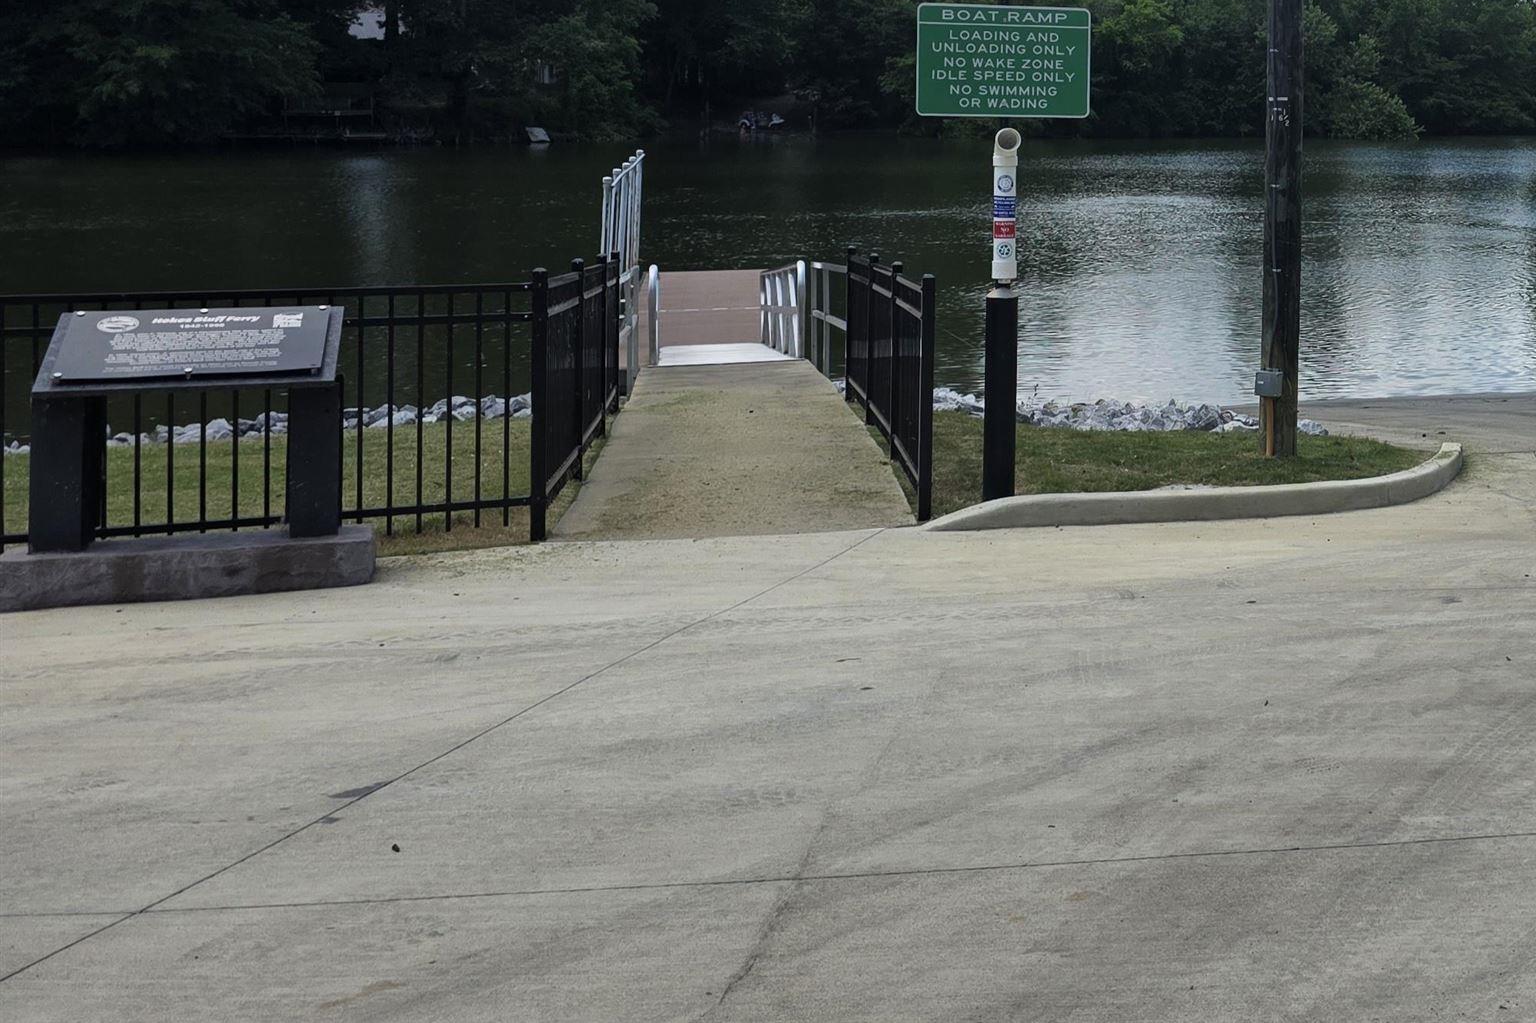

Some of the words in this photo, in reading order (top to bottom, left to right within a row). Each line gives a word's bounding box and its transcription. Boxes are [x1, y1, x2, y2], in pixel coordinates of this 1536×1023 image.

[942, 9, 999, 21] BOAT
[1007, 11, 1067, 23] RAMP
[949, 29, 1020, 41] LOADING
[1026, 32, 1059, 43] AND
[932, 42, 1026, 54] UNLOADING
[1032, 45, 1076, 56] ONLY
[944, 57, 966, 68] NO
[972, 58, 1015, 69] WAKE
[1021, 59, 1064, 70] ZONE
[931, 69, 967, 80] IDLE
[973, 70, 1026, 81] SPEED
[1032, 72, 1075, 83] ONLY
[949, 84, 972, 95] NO
[979, 85, 1058, 97] SWIMMING
[959, 97, 981, 108] OR
[988, 98, 1048, 109] WADING
